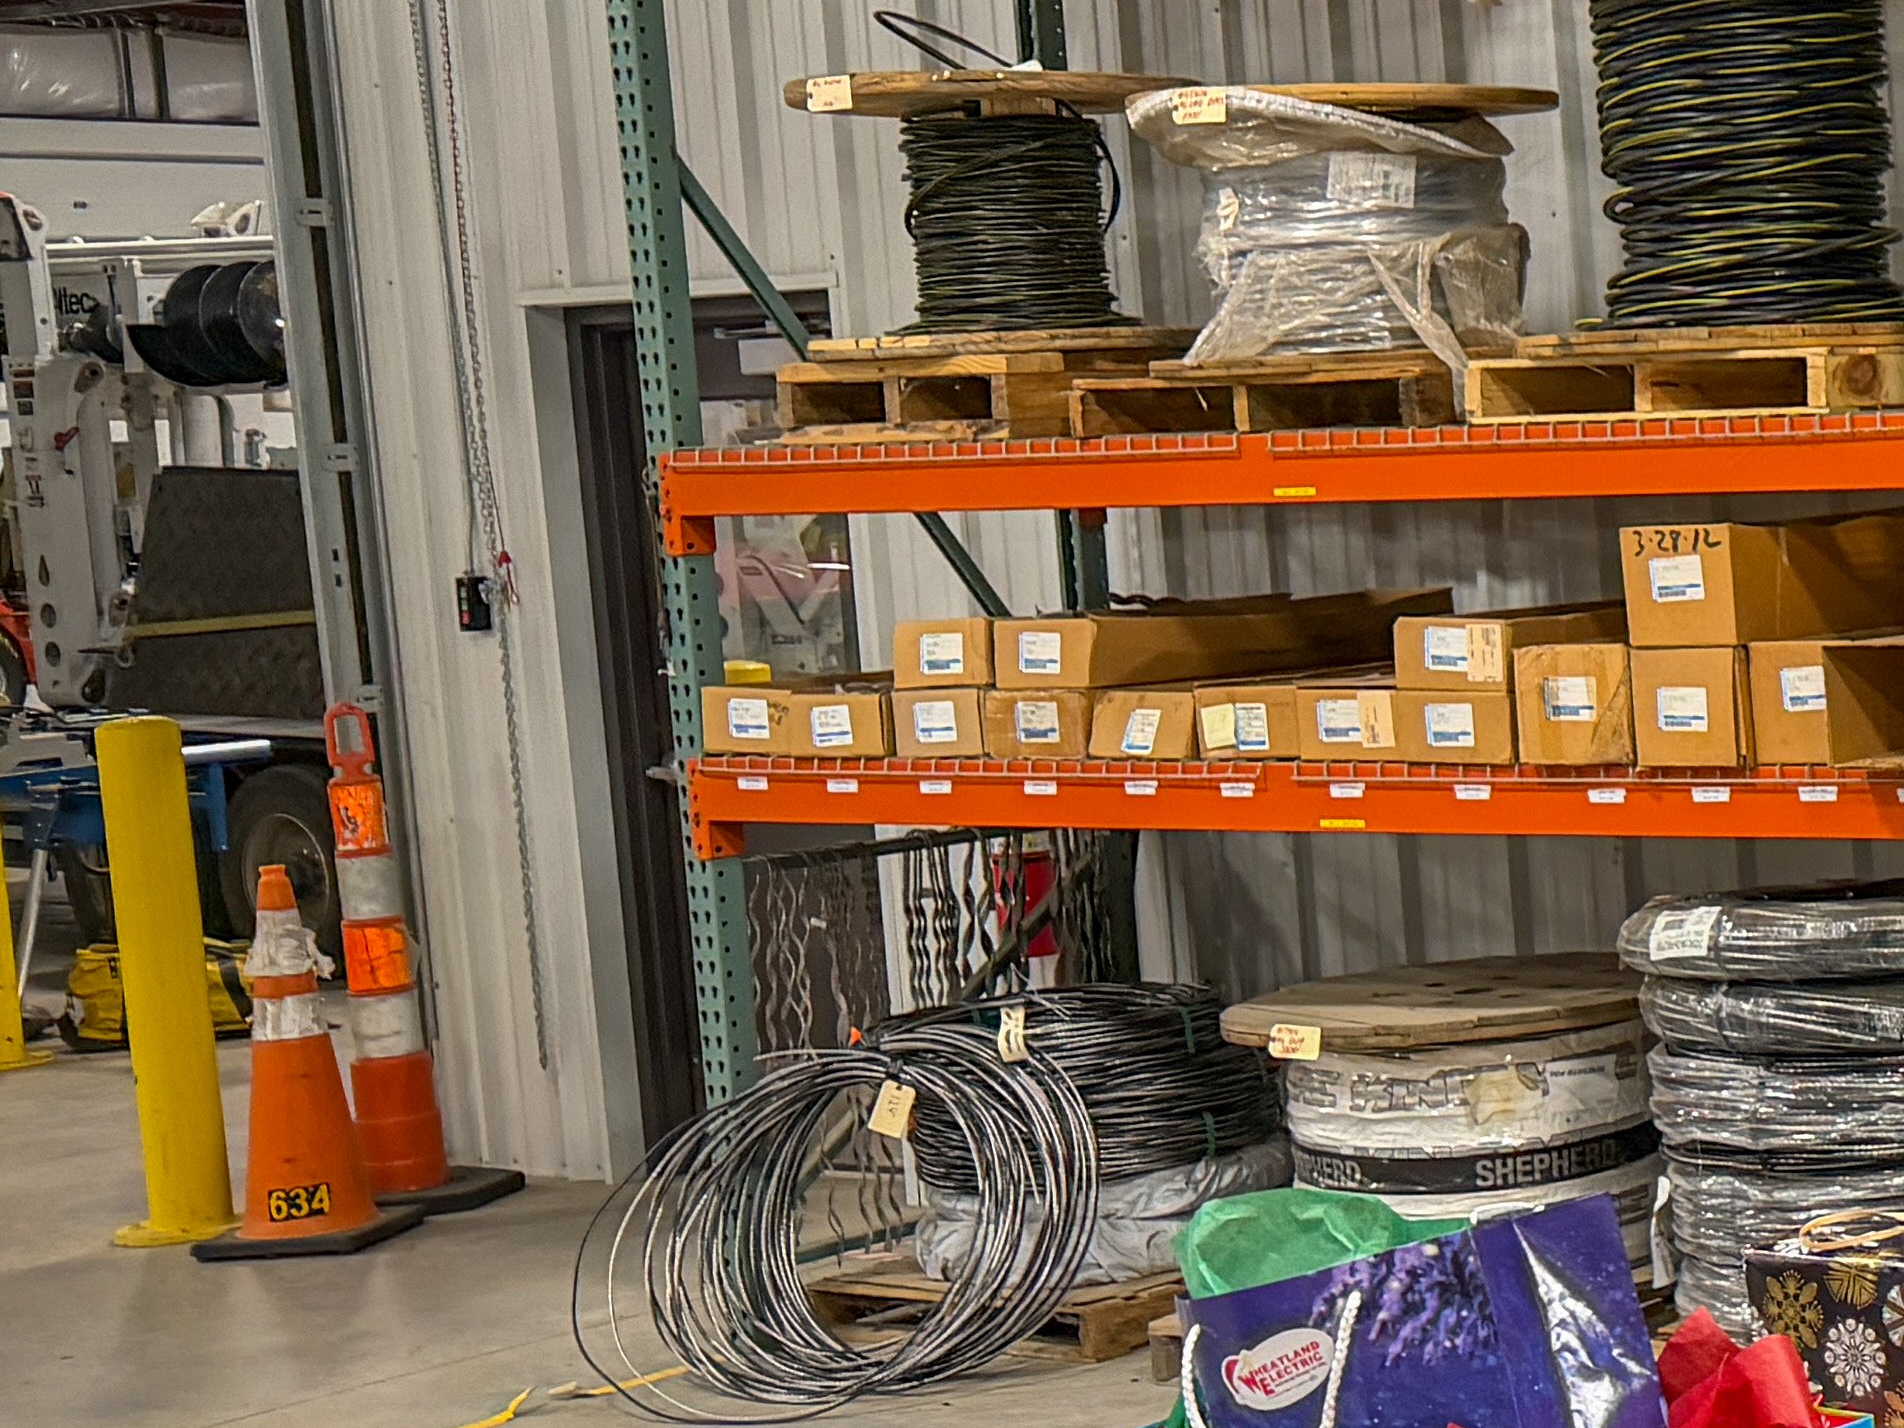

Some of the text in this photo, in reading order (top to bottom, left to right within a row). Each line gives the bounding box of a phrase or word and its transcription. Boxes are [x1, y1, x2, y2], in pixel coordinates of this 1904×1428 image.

[1475, 1139, 1619, 1188] SHEPHERD
[269, 1183, 331, 1221] 634
[1237, 1340, 1320, 1394] WHEATLAND
[1258, 1351, 1323, 1397] ELECTRIC
